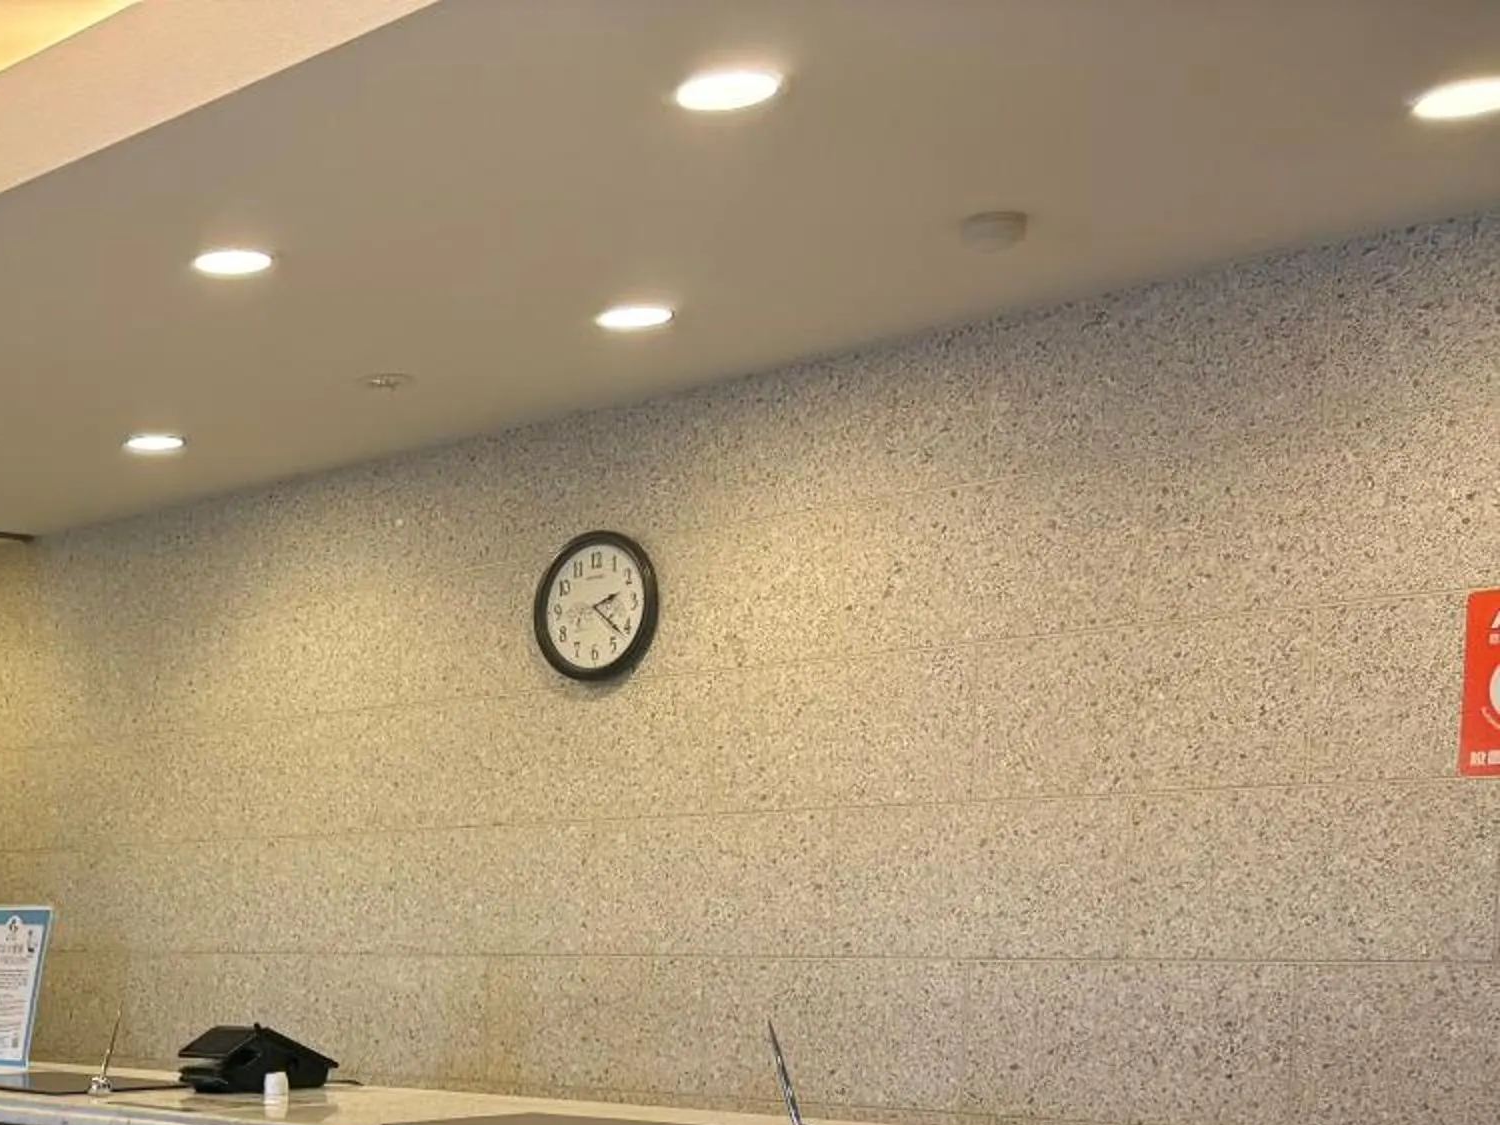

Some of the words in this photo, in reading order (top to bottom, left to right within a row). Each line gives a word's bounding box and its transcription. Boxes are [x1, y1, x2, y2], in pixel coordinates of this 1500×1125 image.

[590, 551, 603, 570] 12
[573, 561, 583, 579] 11
[623, 568, 632, 586] 2
[558, 579, 571, 597] 10
[553, 603, 563, 621] 9
[559, 625, 568, 643] 8
[573, 641, 581, 658] 7
[591, 643, 599, 661] 6
[609, 636, 618, 654] 5
